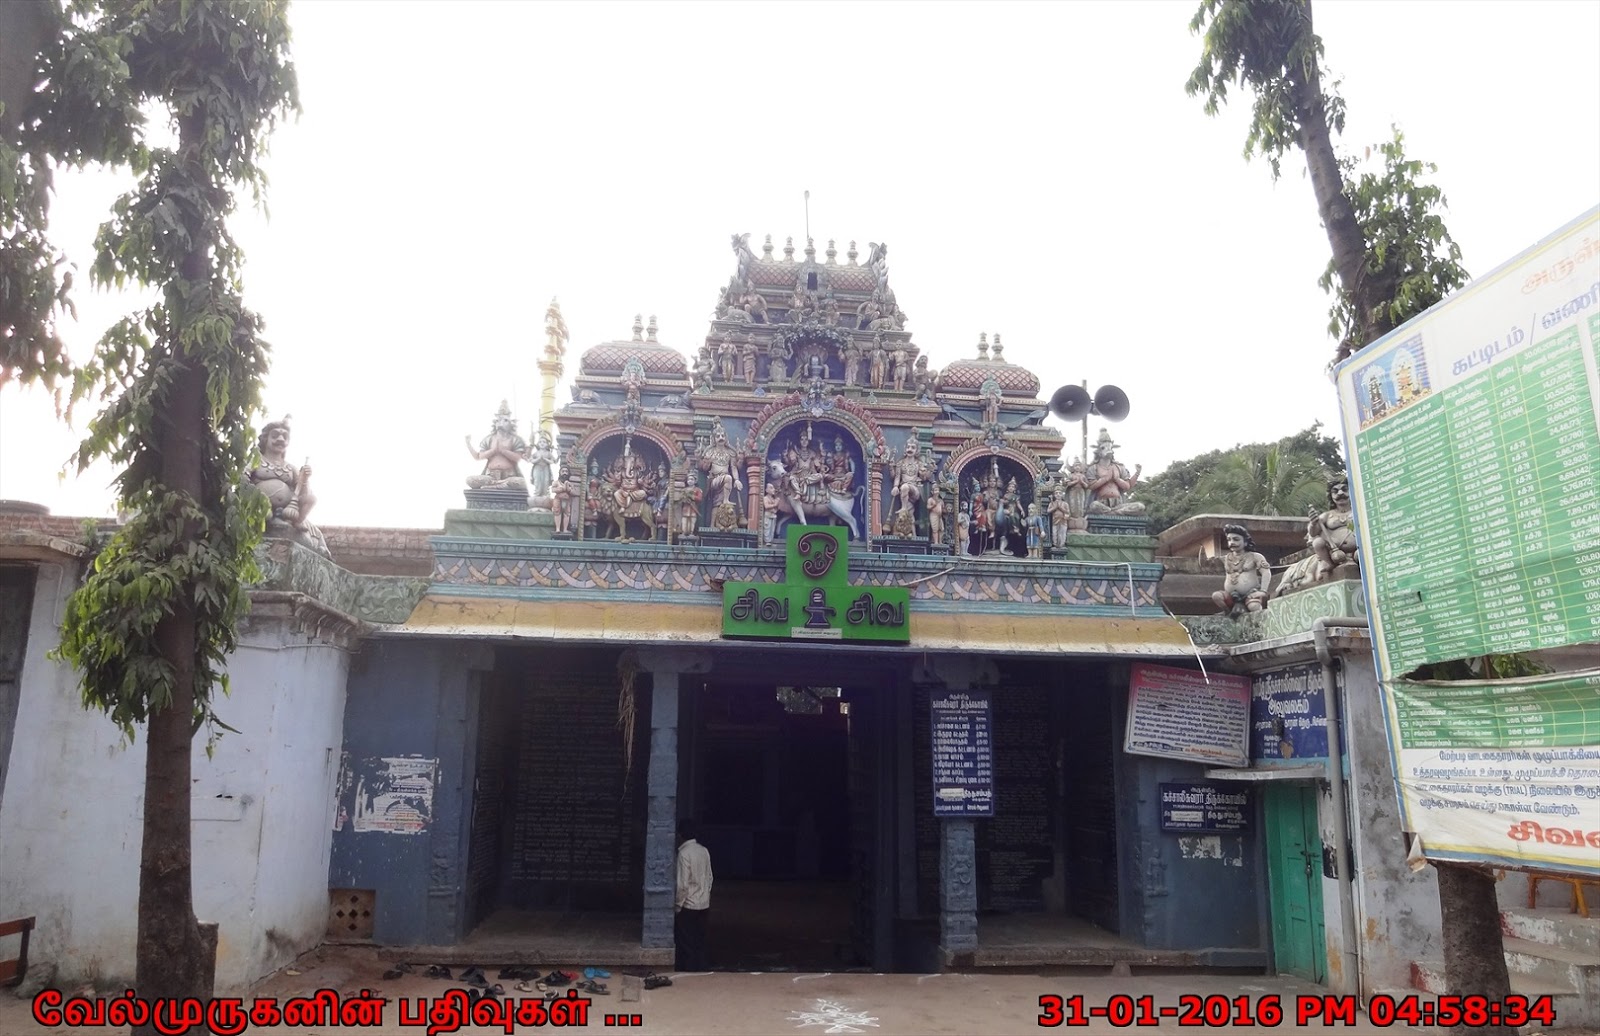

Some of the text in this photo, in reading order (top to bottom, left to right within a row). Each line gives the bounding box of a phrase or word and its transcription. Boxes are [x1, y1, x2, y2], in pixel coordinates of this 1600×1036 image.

[1452, 326, 1525, 376] கட்டிடம்
[730, 588, 789, 623] சிவ
[846, 592, 905, 625] சிவ
[1439, 750, 1466, 763] மேற்படி
[1503, 783, 1528, 797] (TRIAL)
[1529, 784, 1572, 797] நிலையில்
[1534, 802, 1580, 817] வேண்டும்.
